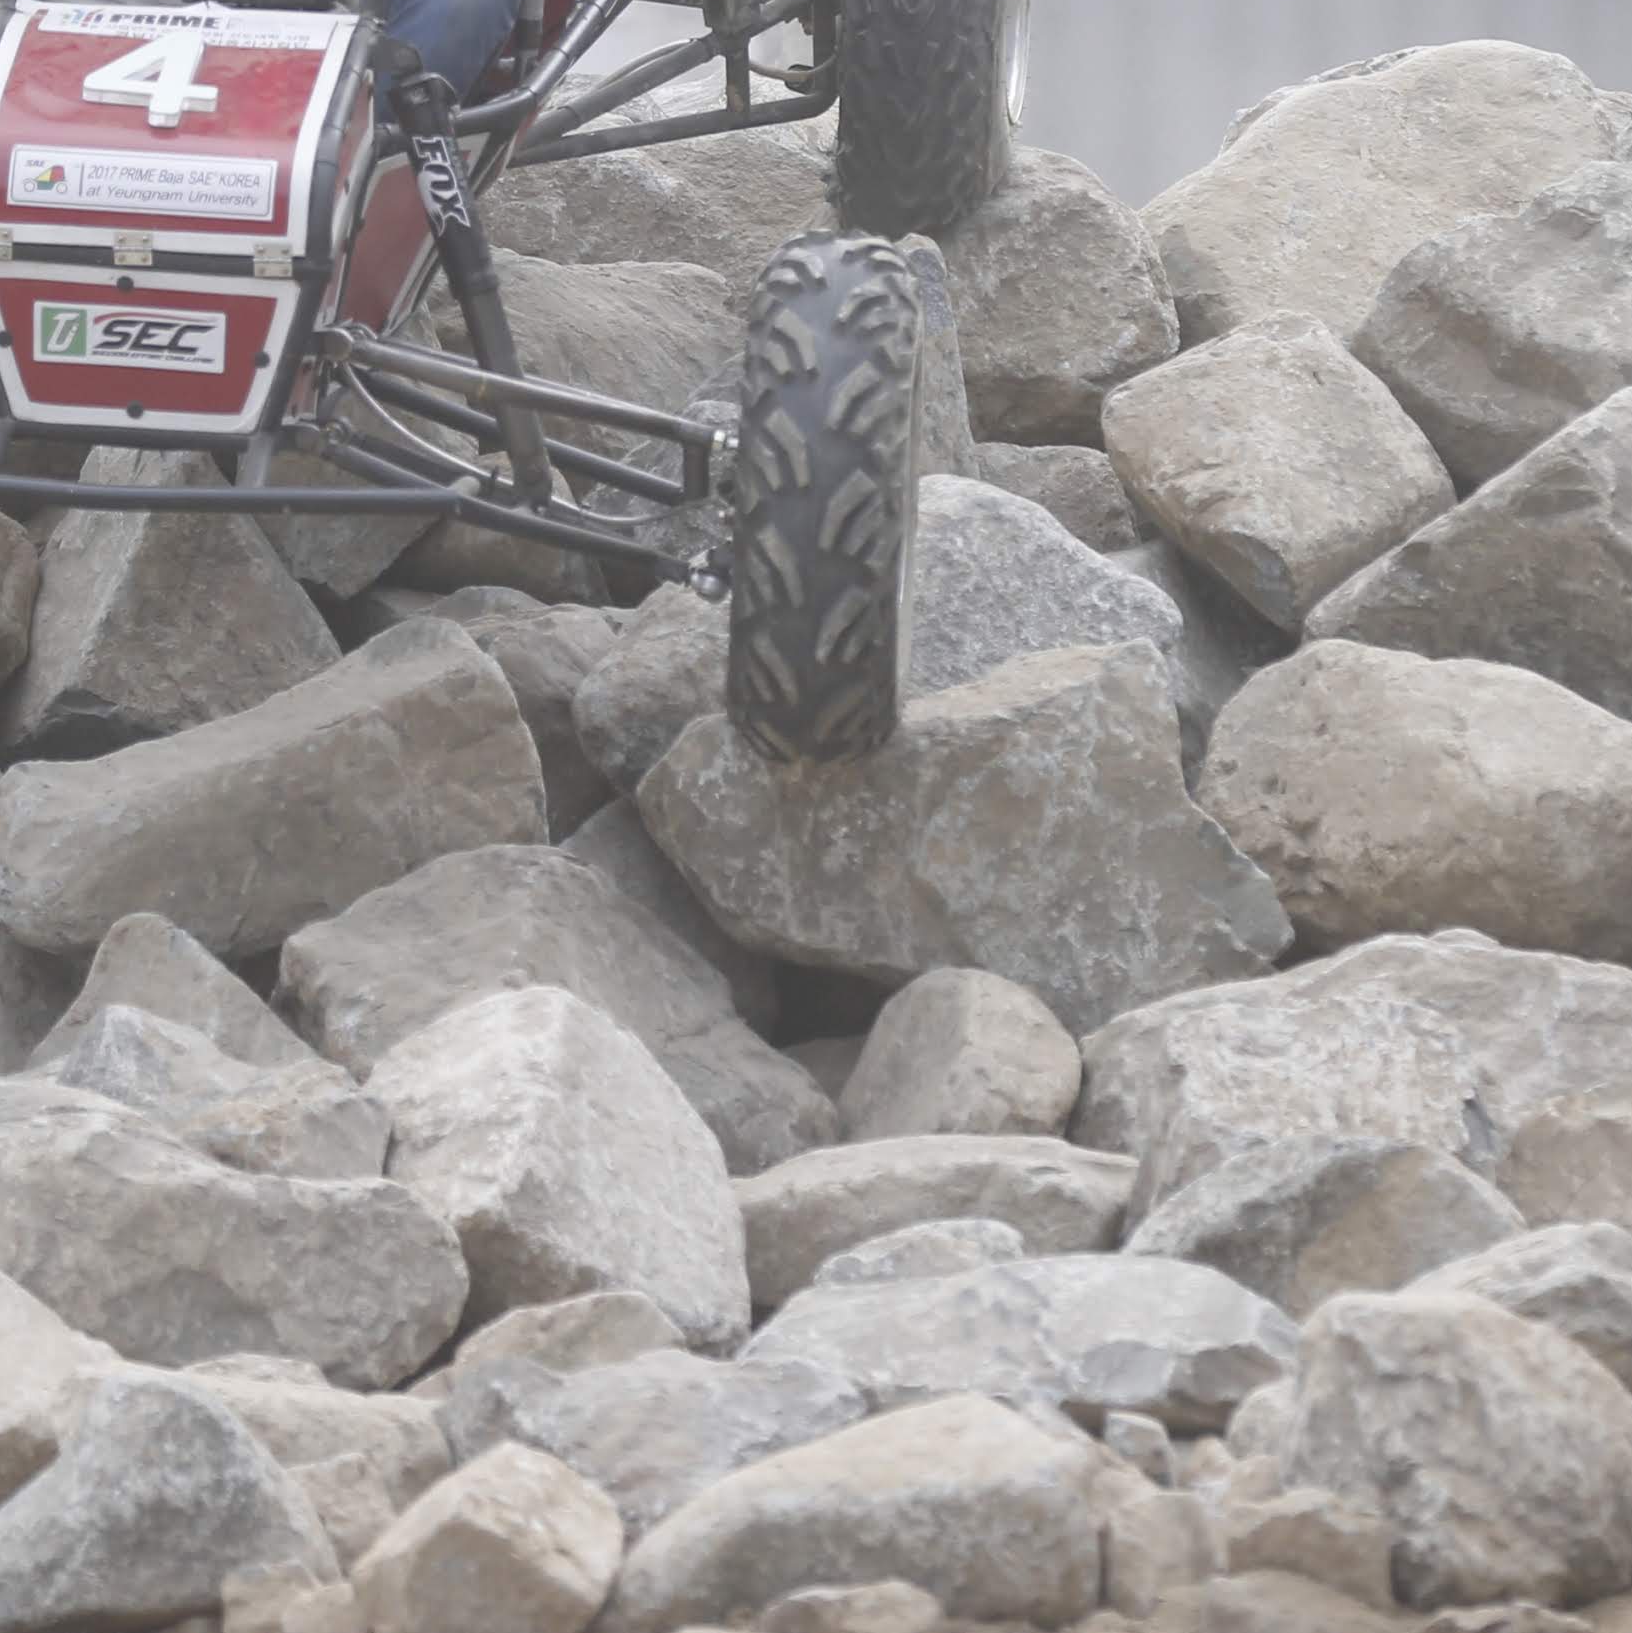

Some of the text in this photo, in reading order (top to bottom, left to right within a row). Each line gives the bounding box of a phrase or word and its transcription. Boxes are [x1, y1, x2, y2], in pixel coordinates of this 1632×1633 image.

[109, 13, 221, 30] PRIME
[82, 31, 219, 128] 4
[87, 165, 117, 180] 2017
[119, 167, 154, 183] PRIME
[157, 170, 184, 186] Baja
[218, 174, 260, 189] KOREA
[412, 136, 471, 230] FOX
[85, 184, 260, 207] at Yeungnam University
[92, 319, 220, 356] SEC
